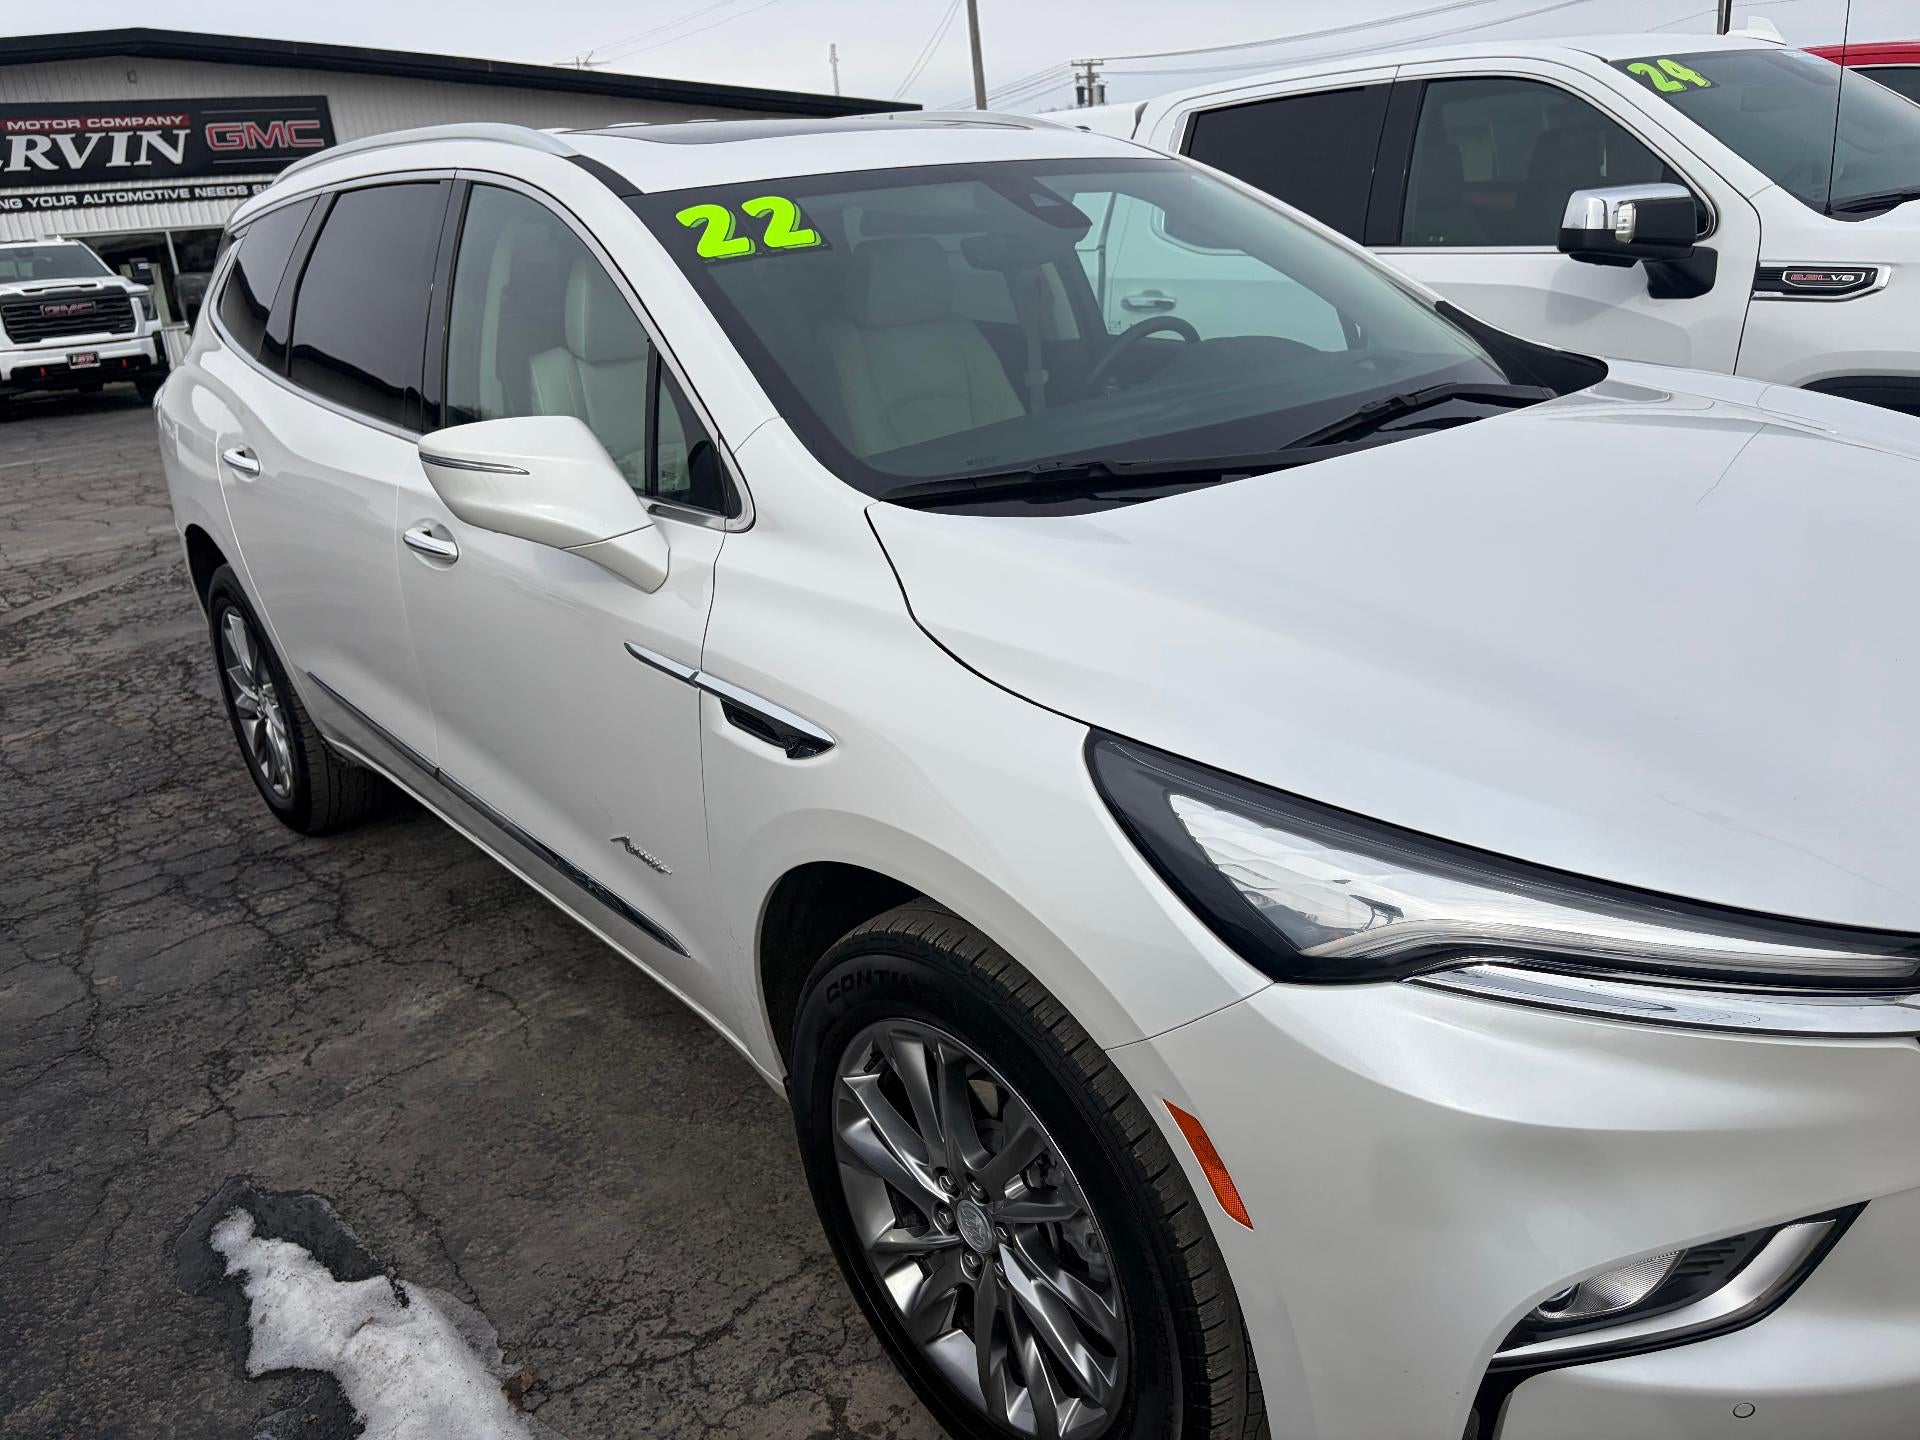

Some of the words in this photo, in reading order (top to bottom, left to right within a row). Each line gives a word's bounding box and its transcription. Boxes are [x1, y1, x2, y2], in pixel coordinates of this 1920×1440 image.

[1626, 59, 1712, 92] 24
[6, 119, 81, 131] MOTOR
[87, 115, 184, 129] COMPANY
[205, 120, 325, 151] GMC
[0, 128, 191, 172] RVIN
[27, 195, 77, 208] YOUR
[82, 187, 190, 203] AUTOMOTIVE
[194, 185, 248, 198] NEEDS
[675, 196, 822, 259] 22
